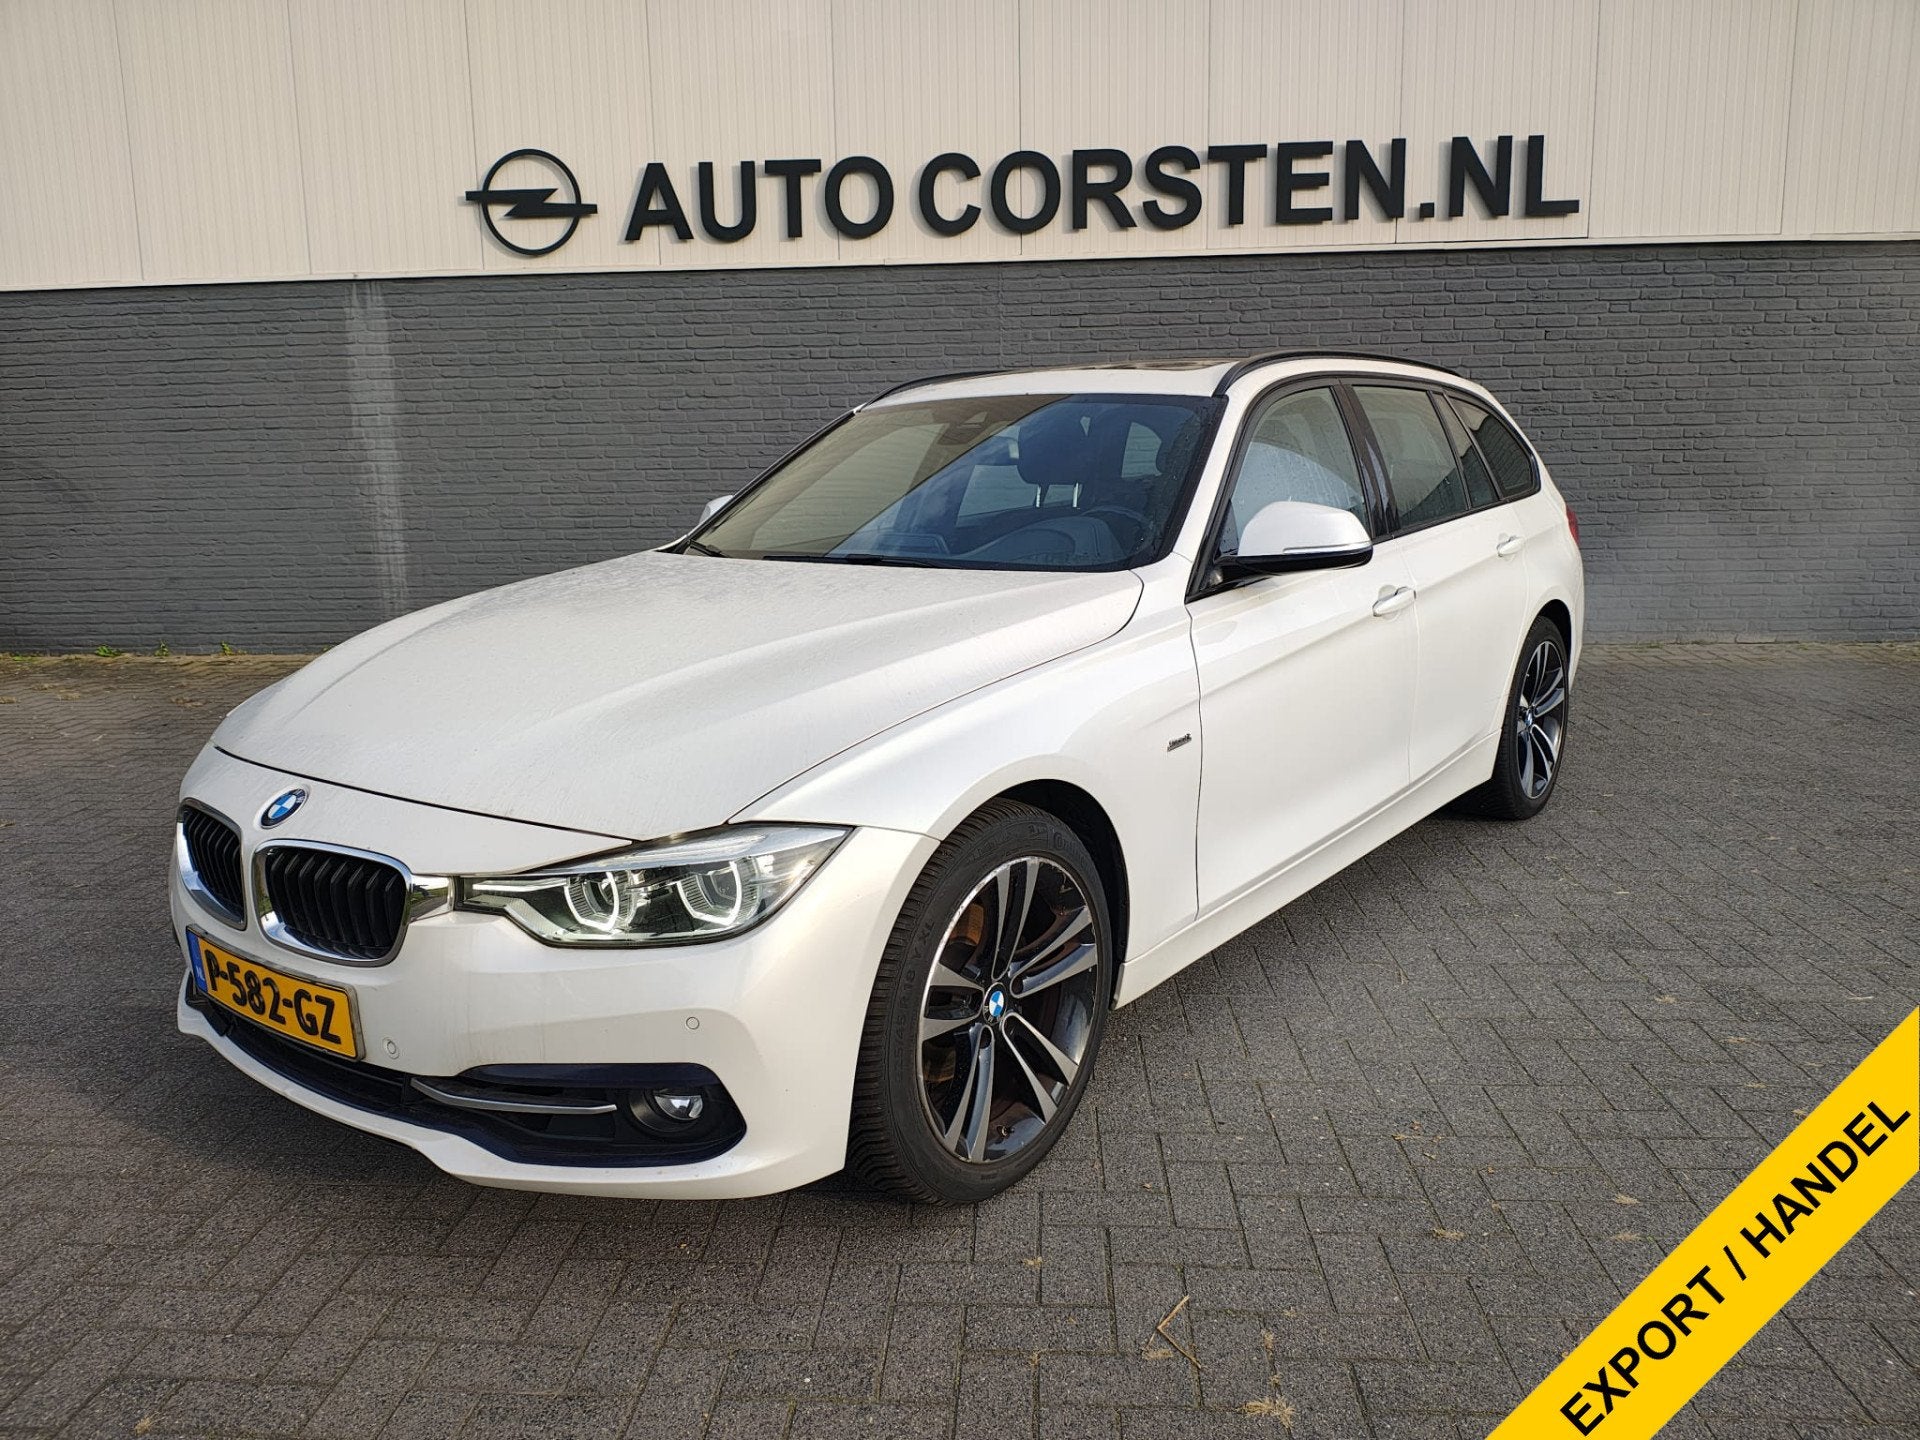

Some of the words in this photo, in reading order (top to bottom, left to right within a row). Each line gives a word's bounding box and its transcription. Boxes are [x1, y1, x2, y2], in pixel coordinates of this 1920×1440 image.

[624, 156, 895, 244] AUTO
[918, 134, 1580, 239] CORSTEN.NL
[204, 949, 342, 1045] P-582-GZ
